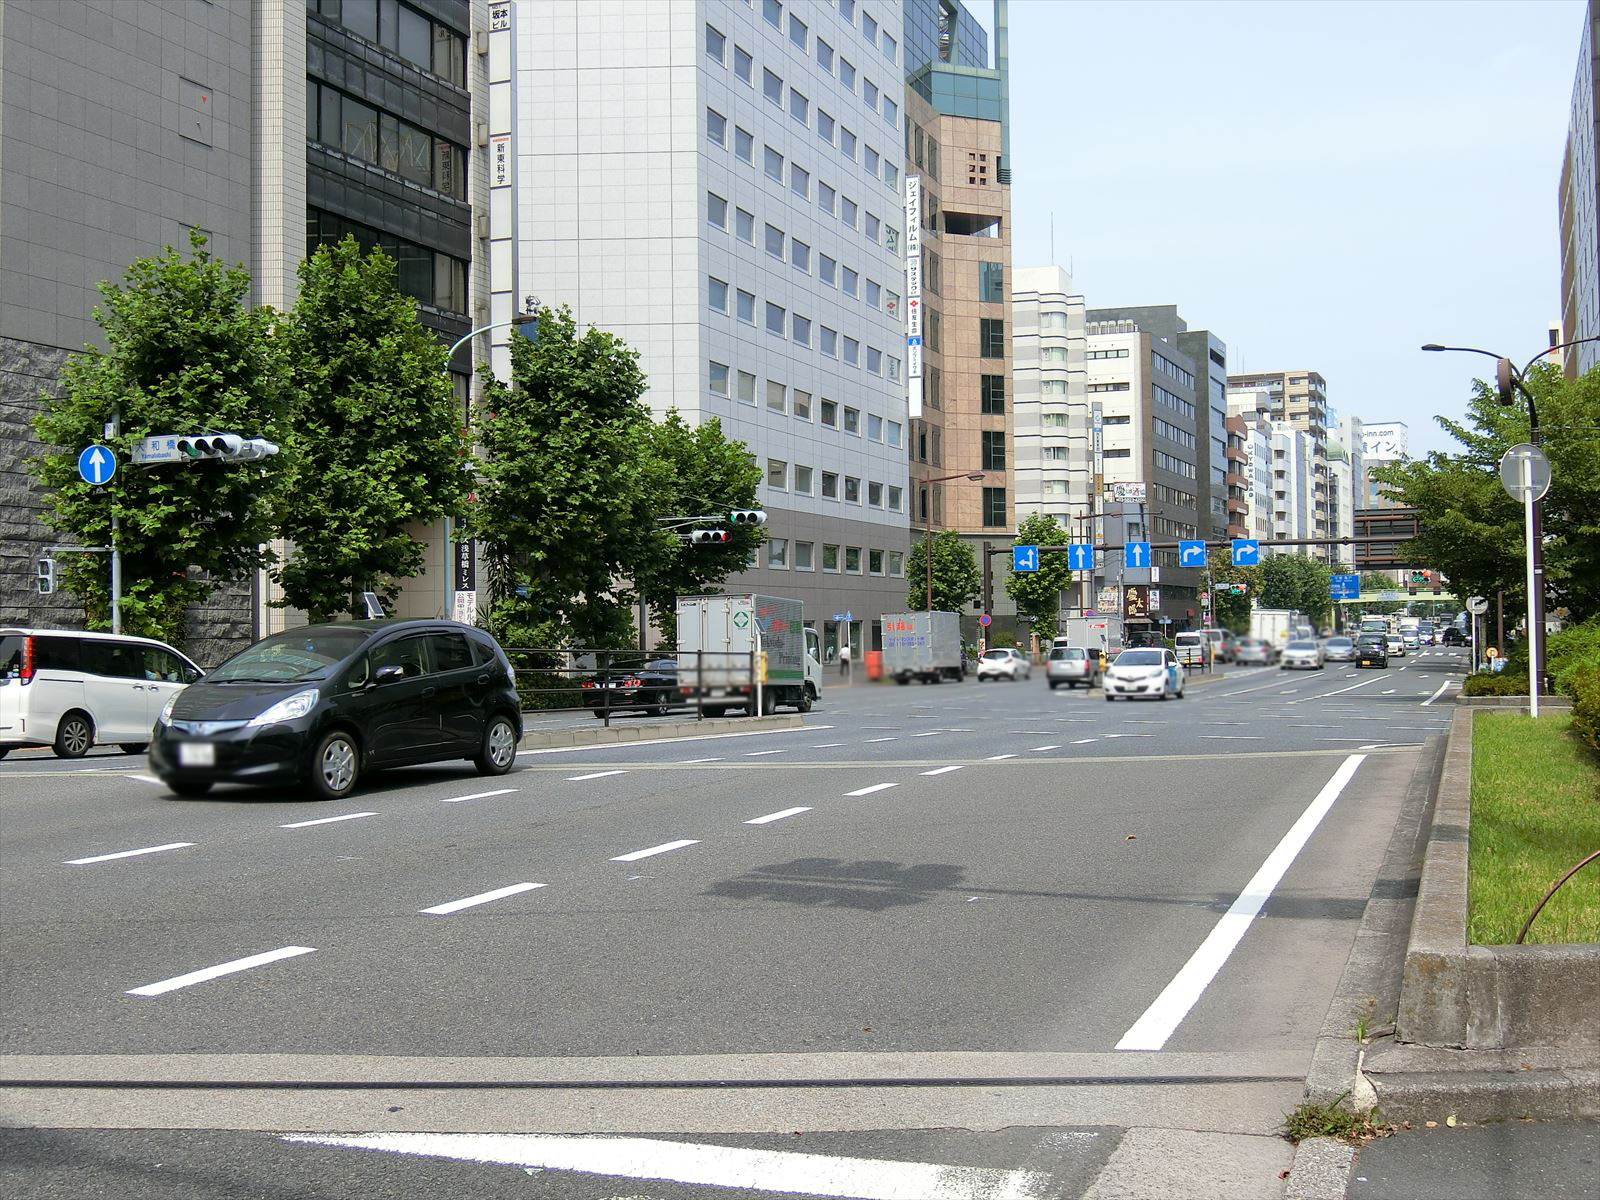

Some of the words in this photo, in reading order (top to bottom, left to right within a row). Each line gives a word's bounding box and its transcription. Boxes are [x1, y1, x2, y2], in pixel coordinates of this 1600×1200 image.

[492, 9, 508, 19] 坂本
[492, 20, 508, 30] ビル
[496, 143, 506, 185] 新東科学
[135, 440, 176, 453] 大和橋
